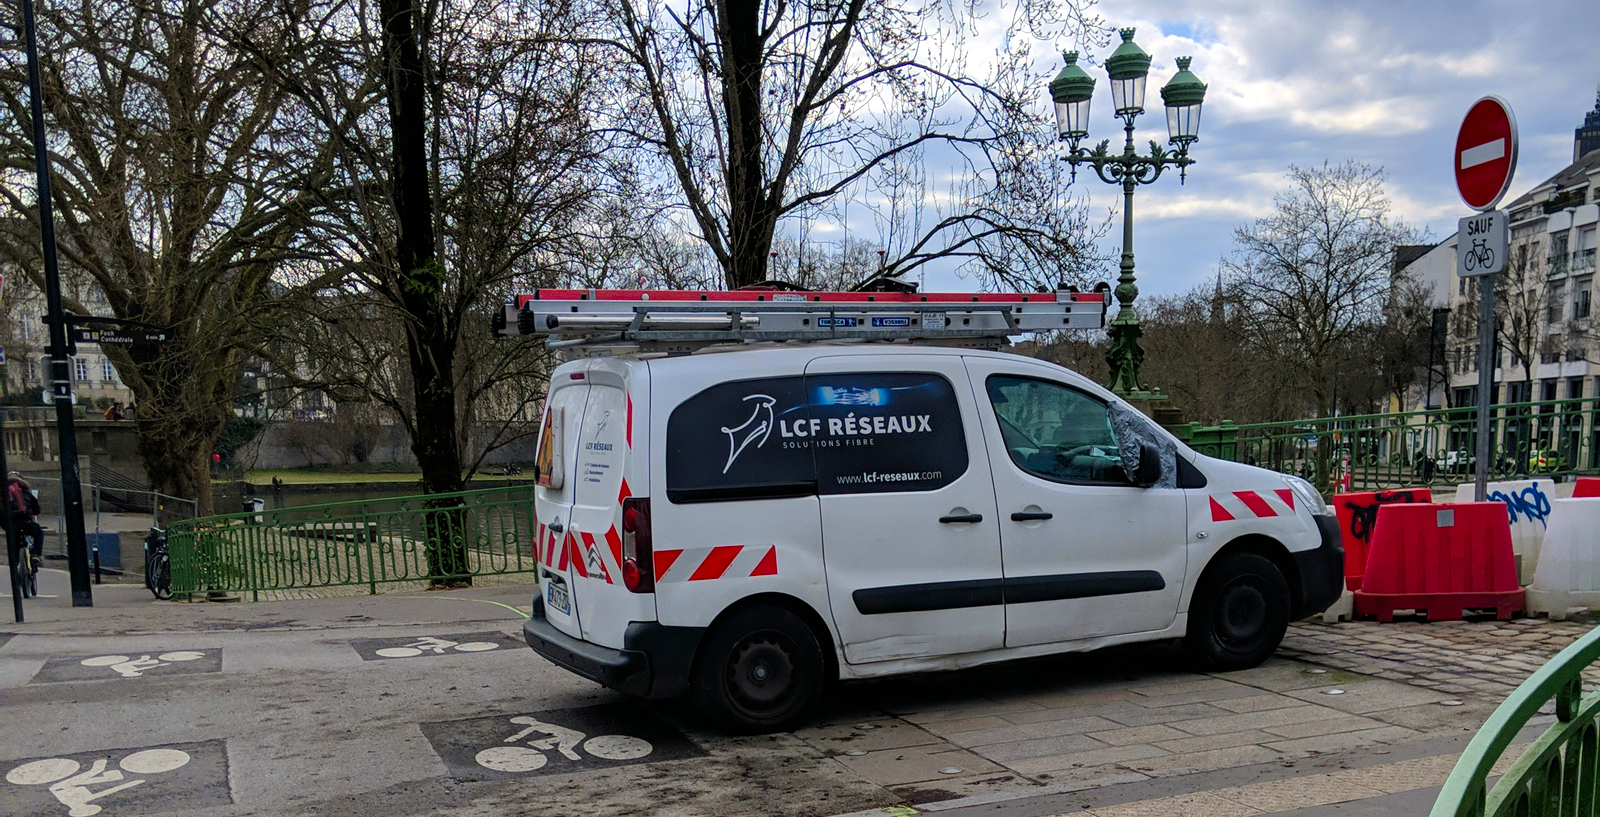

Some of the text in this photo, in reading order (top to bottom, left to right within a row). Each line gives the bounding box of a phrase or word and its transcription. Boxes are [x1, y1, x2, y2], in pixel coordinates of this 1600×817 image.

[1468, 217, 1494, 236] SAUF
[780, 412, 932, 437] LCF RÉSEAUX
[586, 441, 613, 451] LCF RÉSEAUX
[783, 438, 875, 449] SOLUTIONS FIBRE
[836, 469, 942, 484] www.lcf-reseaux.com
